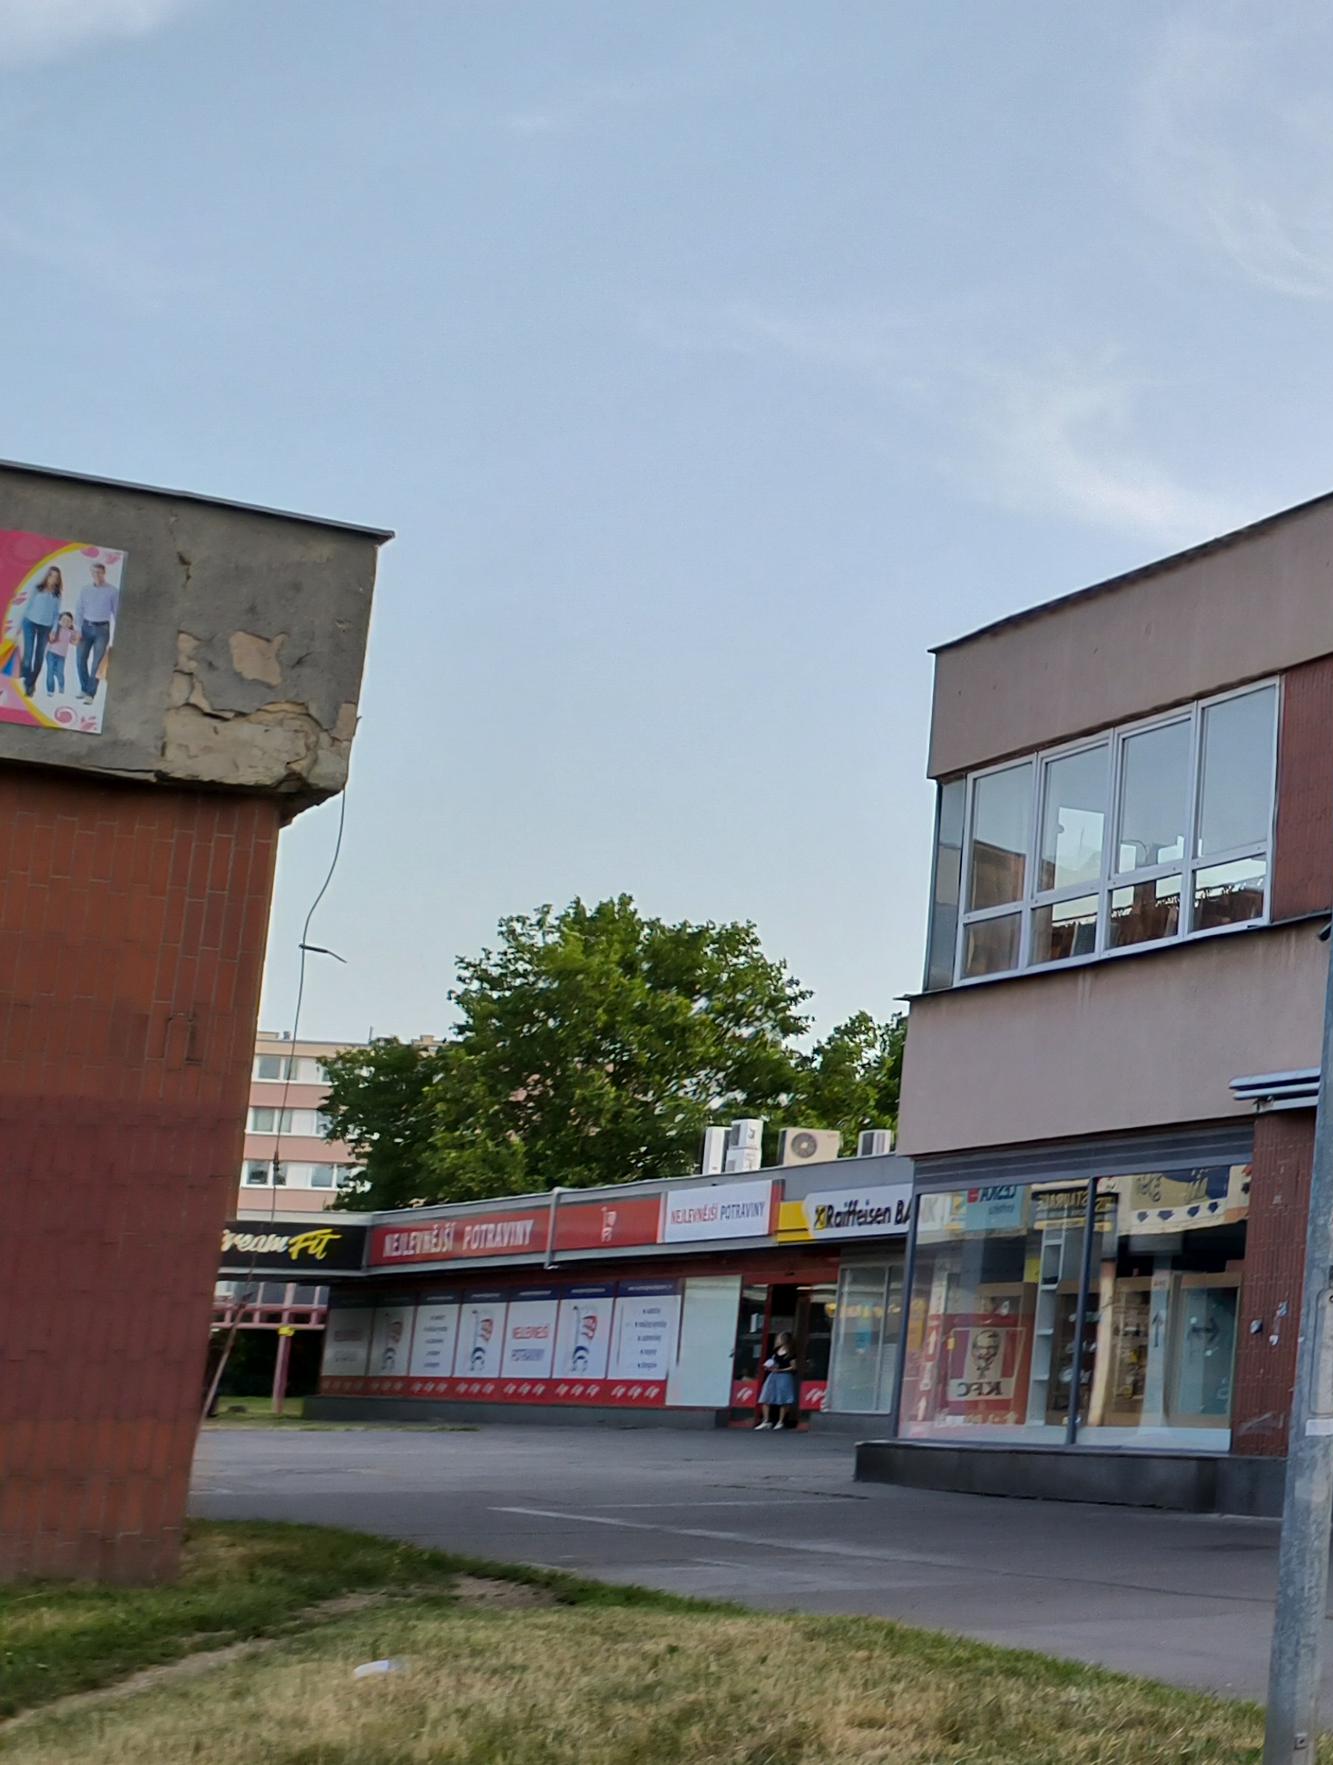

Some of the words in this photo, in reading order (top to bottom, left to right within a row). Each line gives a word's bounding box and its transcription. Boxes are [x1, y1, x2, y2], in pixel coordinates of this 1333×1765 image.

[720, 1201, 765, 1220] POTRAVINY
[826, 1199, 891, 1228] Raiffeisen
[462, 1219, 534, 1250] POTRAVINY
